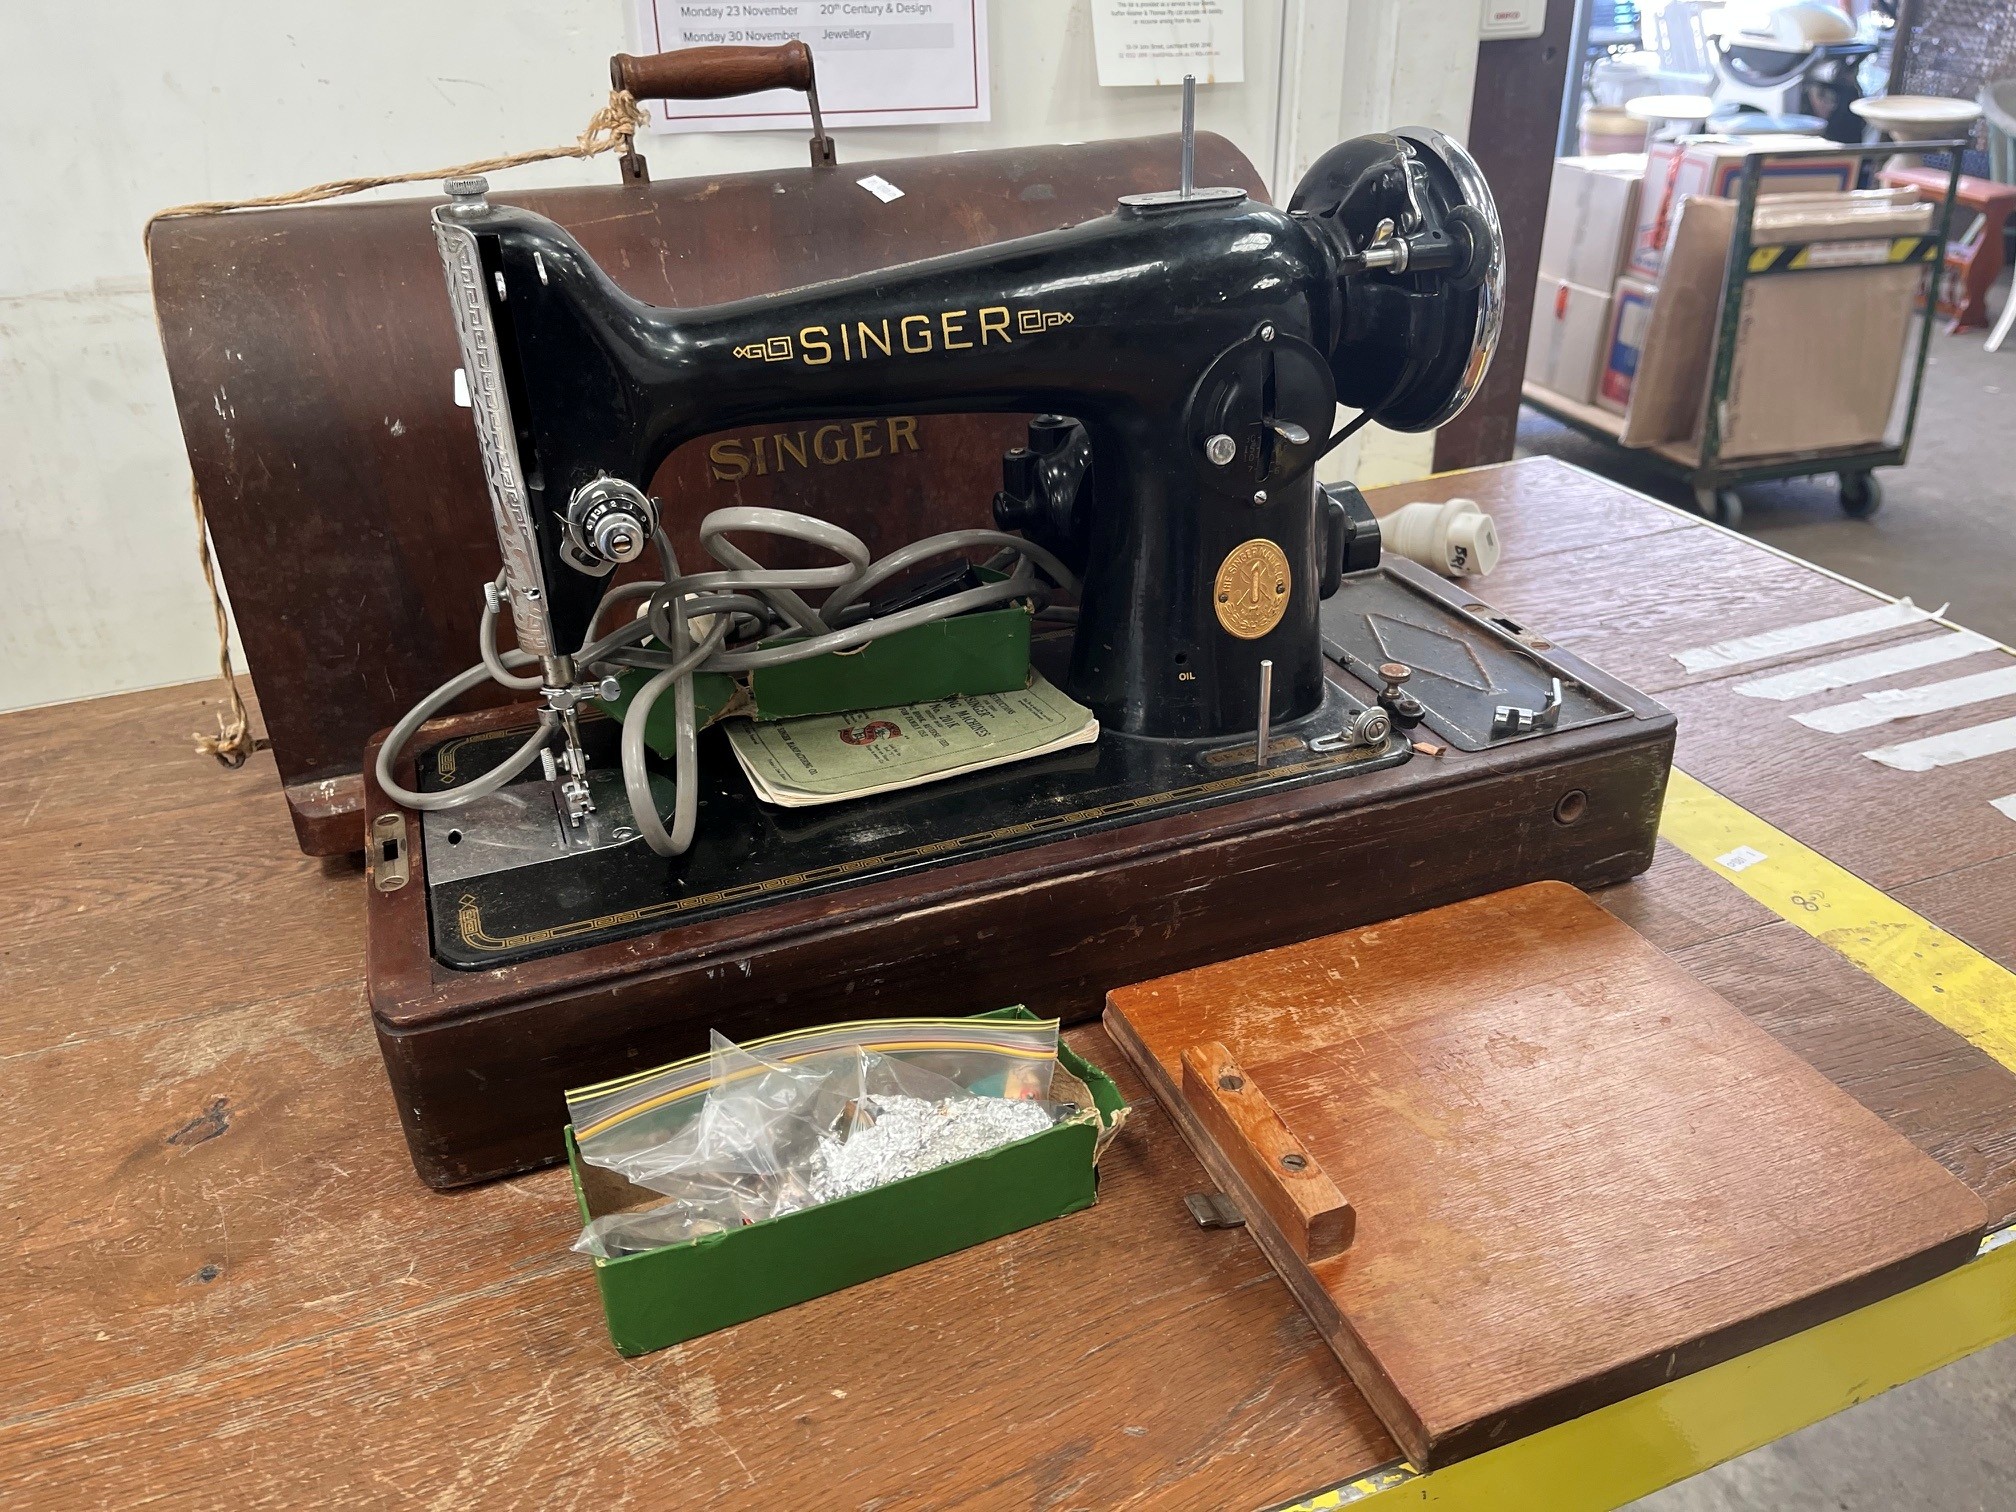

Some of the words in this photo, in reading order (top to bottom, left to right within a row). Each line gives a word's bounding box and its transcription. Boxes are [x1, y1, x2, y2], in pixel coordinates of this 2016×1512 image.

[681, 6, 724, 20] Monday
[726, 5, 740, 16] 23
[743, 4, 799, 16] November
[842, 3, 884, 16] Century
[885, 3, 893, 14] &
[896, 2, 932, 15] Design
[683, 31, 726, 43] Monday
[728, 30, 743, 41] 30
[745, 29, 801, 41] November
[822, 28, 871, 41] Jewellery
[799, 306, 1012, 366] SINGER
[709, 416, 921, 481] SINGER
[610, 500, 617, 508] 2
[1228, 547, 1258, 574] SINGER
[1178, 672, 1196, 681] OIL
[989, 693, 1017, 716] STRUCTIONS
[939, 714, 960, 729] 201K
[956, 710, 990, 738] MACHINES
